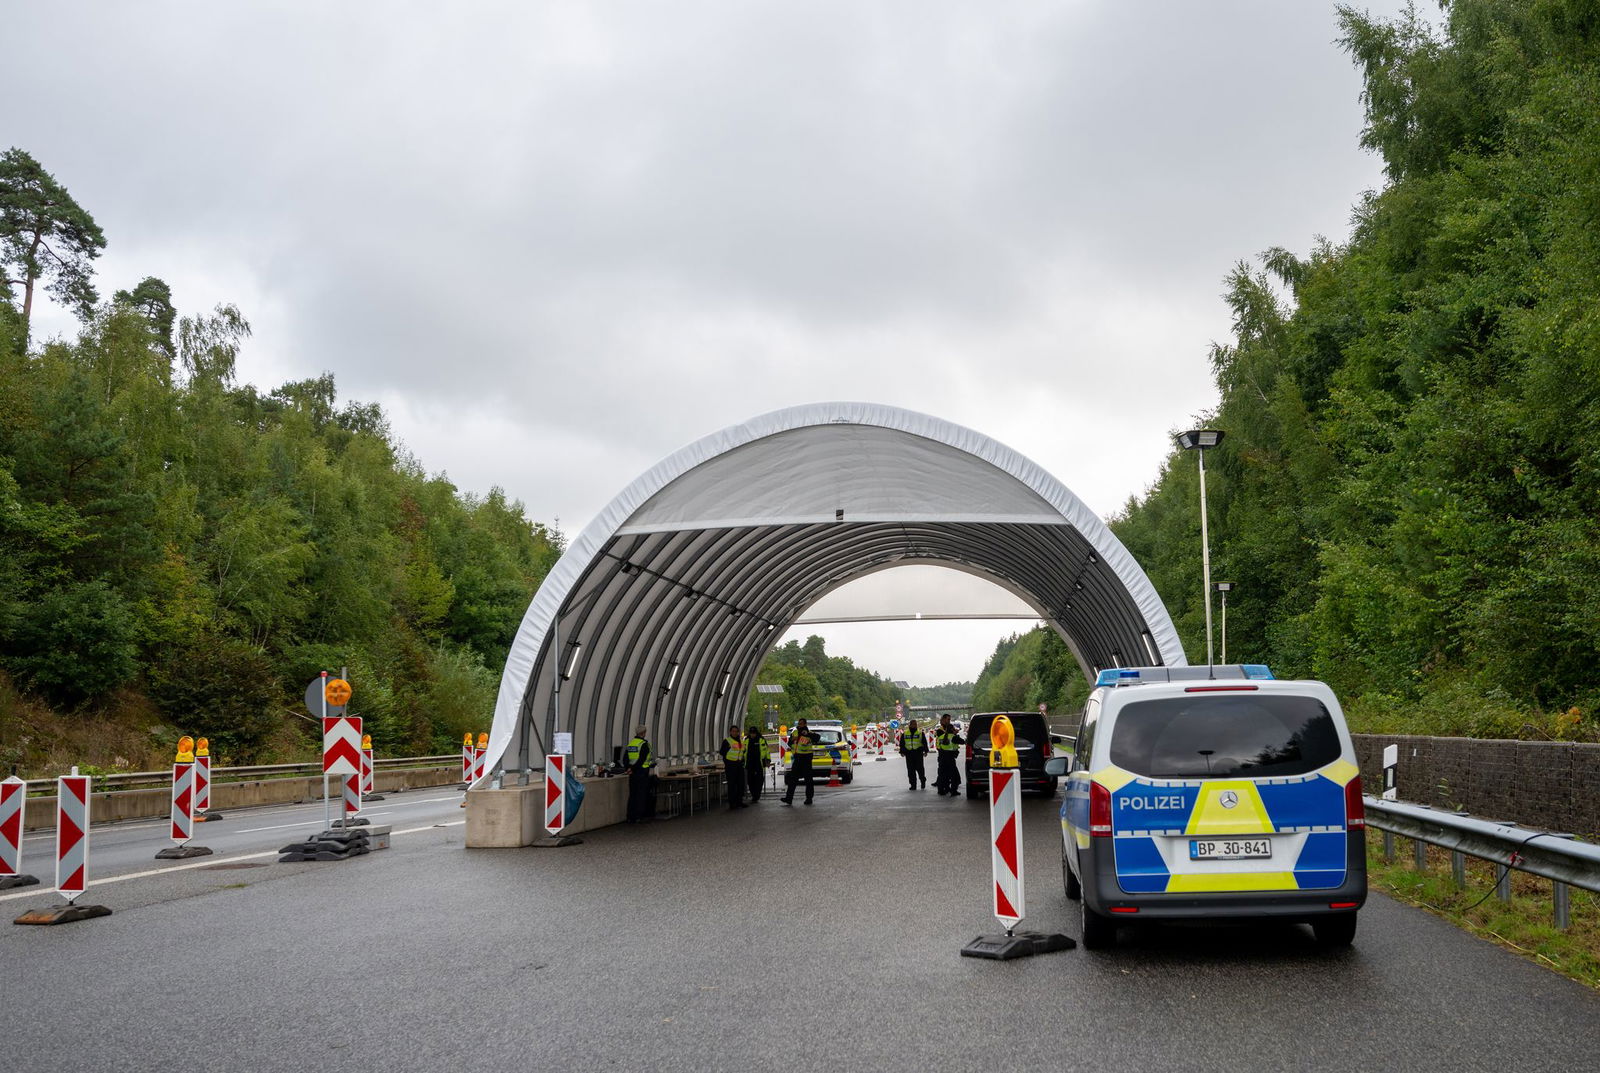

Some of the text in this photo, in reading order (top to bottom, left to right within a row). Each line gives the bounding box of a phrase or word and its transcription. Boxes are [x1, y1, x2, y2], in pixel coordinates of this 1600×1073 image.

[1119, 796, 1185, 810] POLIZEI
[1198, 841, 1269, 855] BP 30-841
